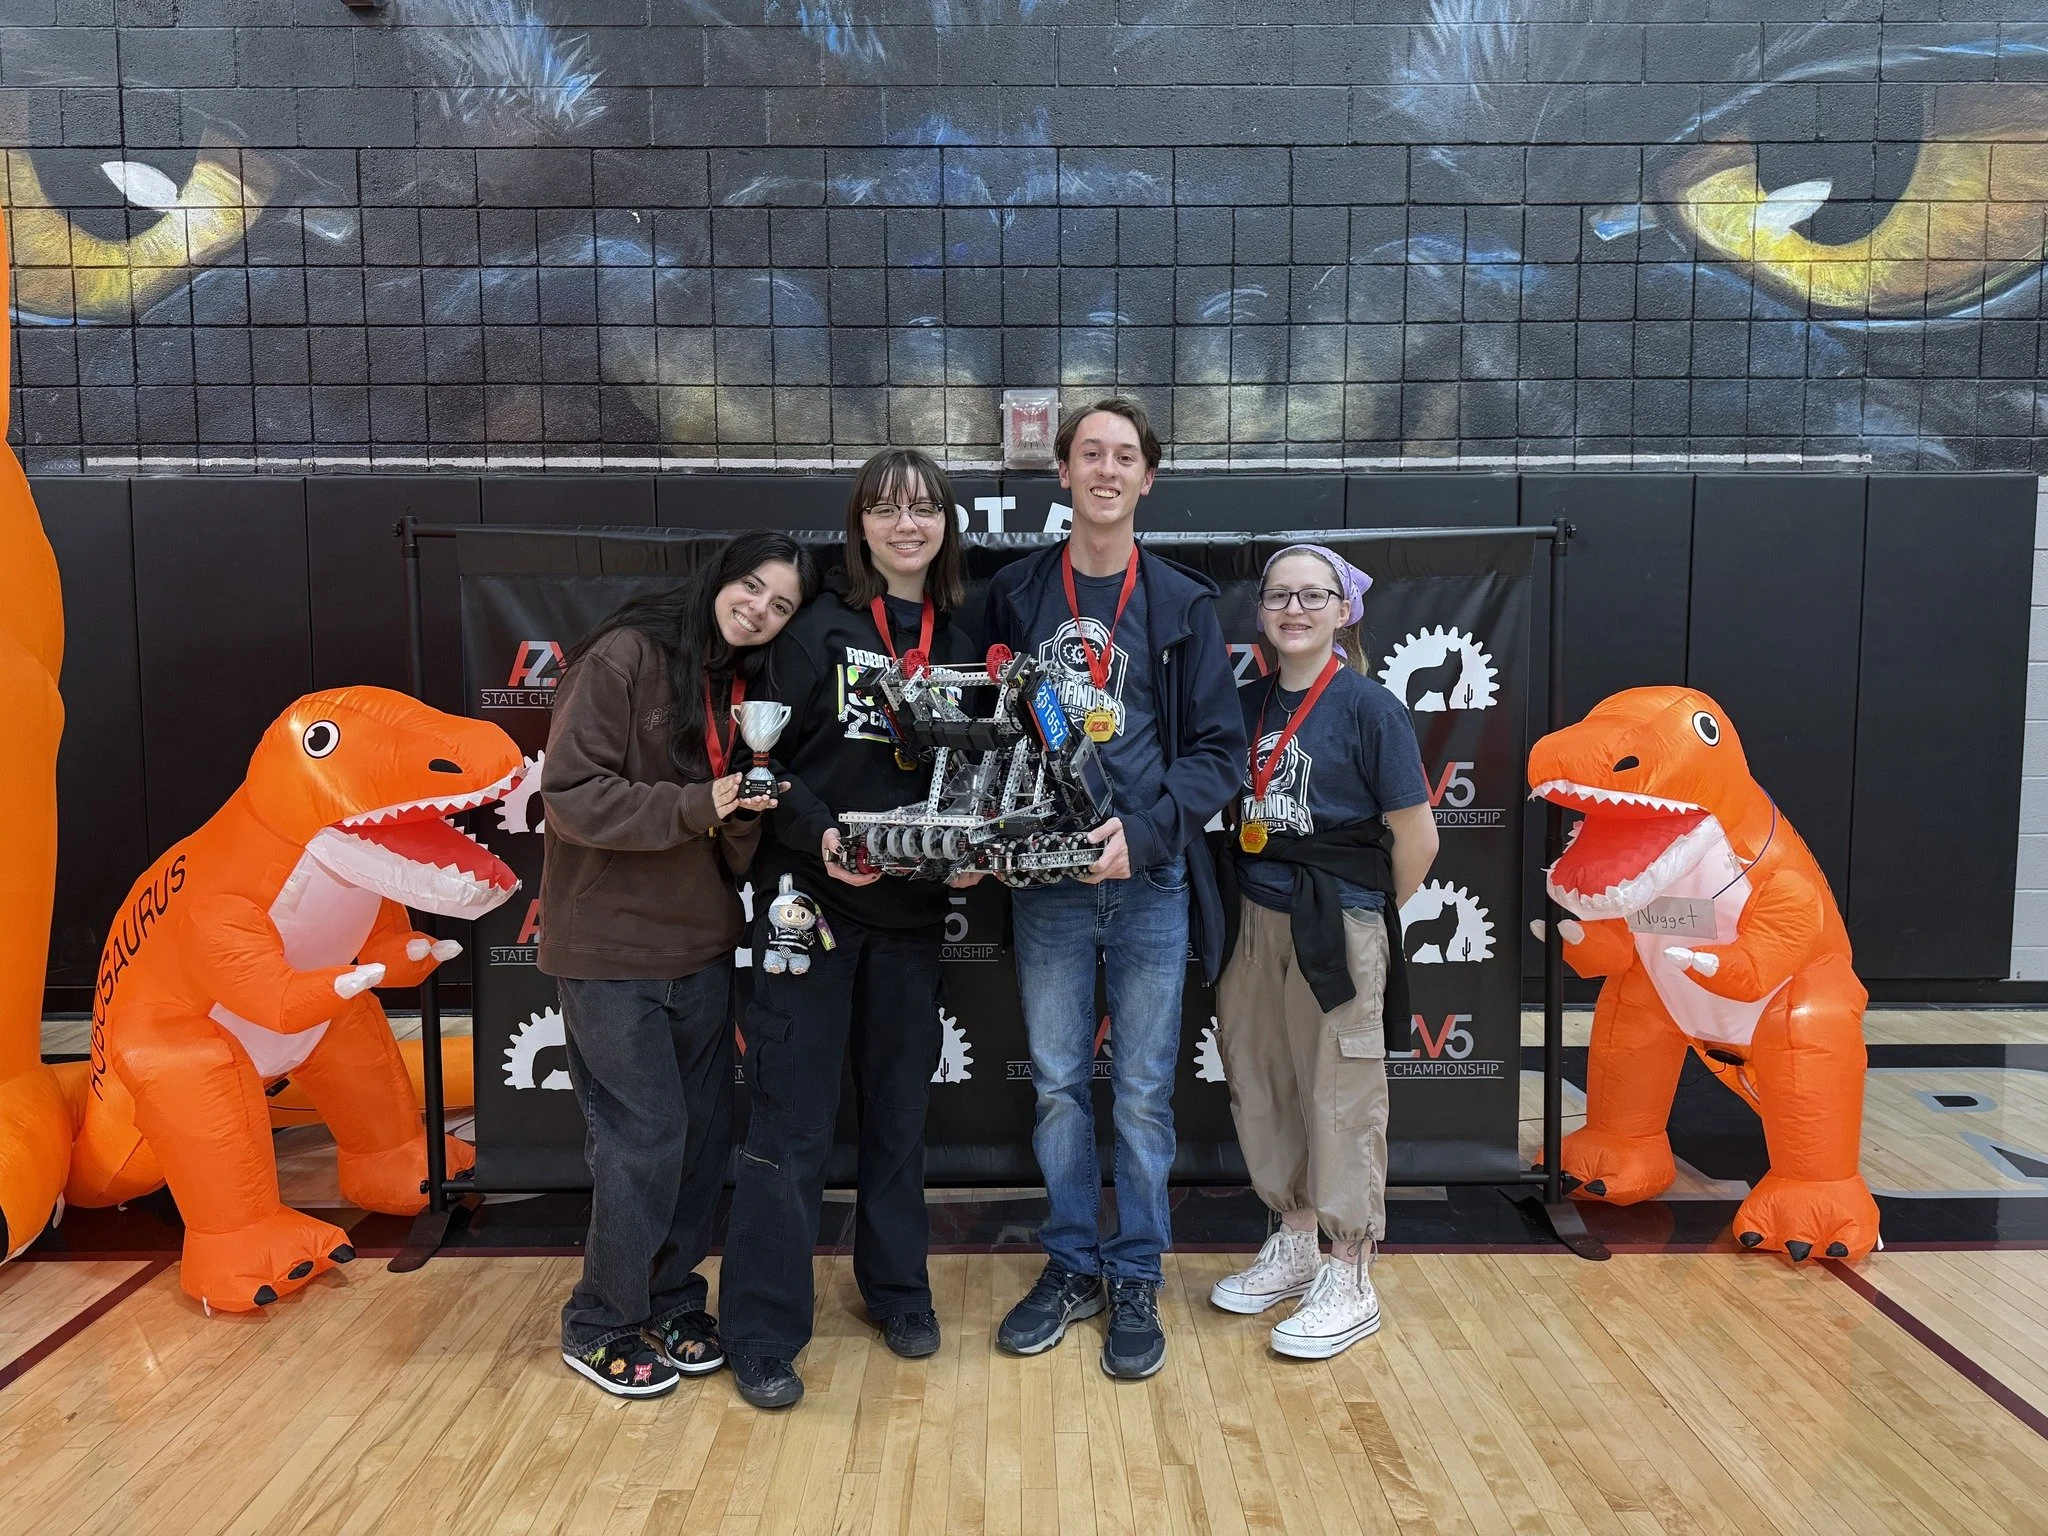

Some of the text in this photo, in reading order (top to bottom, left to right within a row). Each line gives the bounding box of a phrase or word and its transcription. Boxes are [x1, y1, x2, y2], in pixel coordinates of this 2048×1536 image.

[846, 647, 893, 672] ROBO
[481, 693, 525, 705] STATE
[1056, 681, 1121, 727] HFINDERS
[1421, 762, 1475, 808] V5
[1434, 812, 1501, 825] PIONSHIP
[1636, 904, 1699, 929] Nugget
[490, 949, 534, 962] STATE
[939, 946, 994, 959] ONSHIP
[1006, 1064, 1032, 1077] STA
[1393, 1063, 1499, 1076] CHAMPIONSHIP
